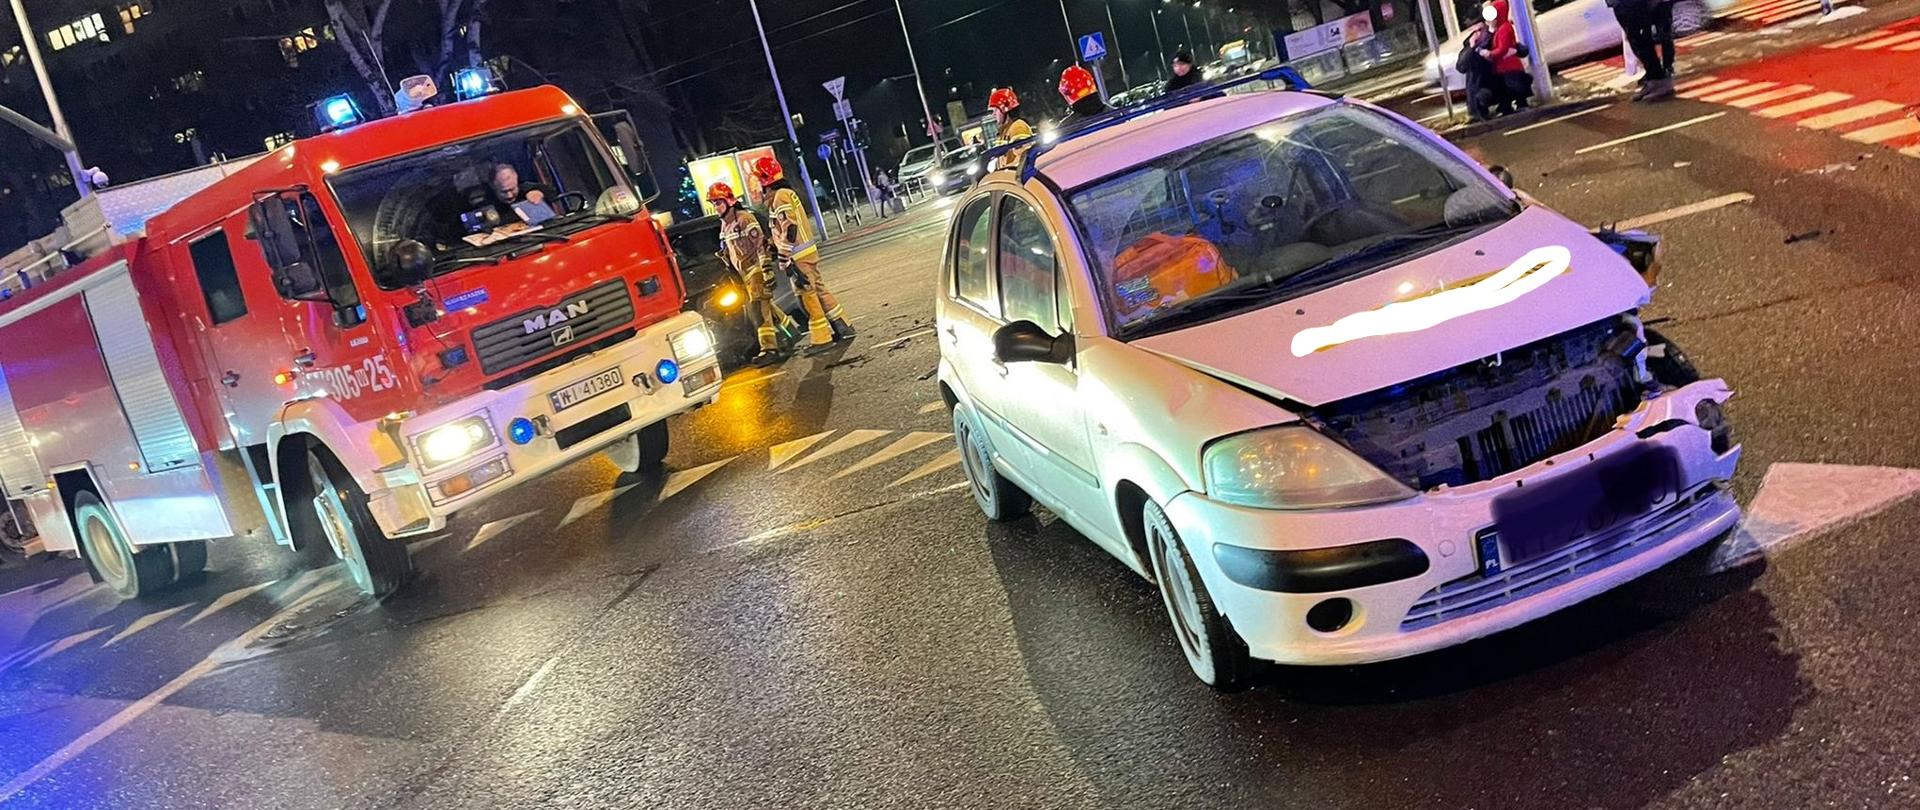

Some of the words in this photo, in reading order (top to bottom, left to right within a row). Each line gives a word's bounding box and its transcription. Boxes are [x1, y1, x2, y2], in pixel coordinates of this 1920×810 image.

[523, 300, 589, 334] MAN
[583, 371, 620, 396] 41380
[1485, 559, 1499, 569] PL
